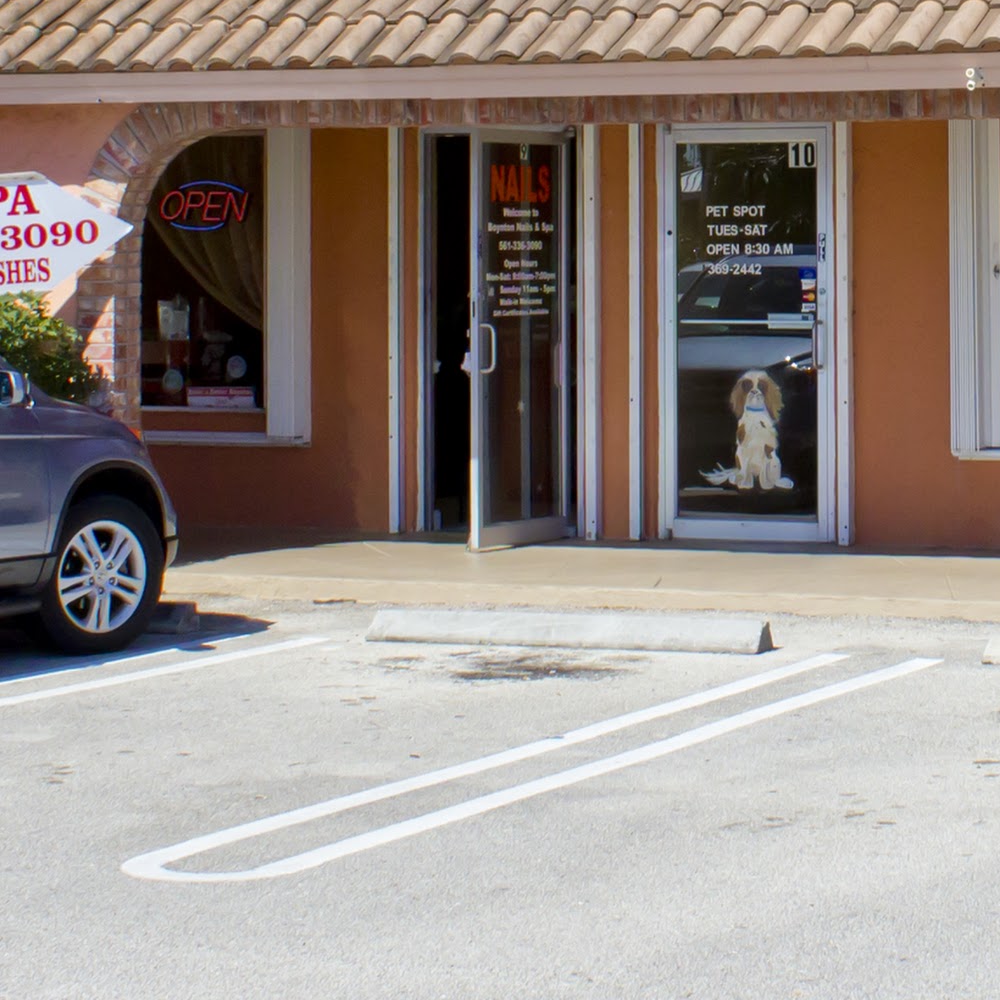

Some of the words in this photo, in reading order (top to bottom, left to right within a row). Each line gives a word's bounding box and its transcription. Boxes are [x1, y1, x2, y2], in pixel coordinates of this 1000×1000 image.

[791, 142, 815, 167] 10
[490, 164, 551, 203] NAILS
[160, 190, 249, 223] OPEN
[706, 205, 729, 217] PET
[733, 205, 766, 217] SPOT
[0, 219, 100, 251] 3090
[706, 243, 740, 255] OPEN
[744, 243, 770, 255] 8:30
[774, 243, 794, 255] AM
[707, 263, 762, 275] 369-2442
